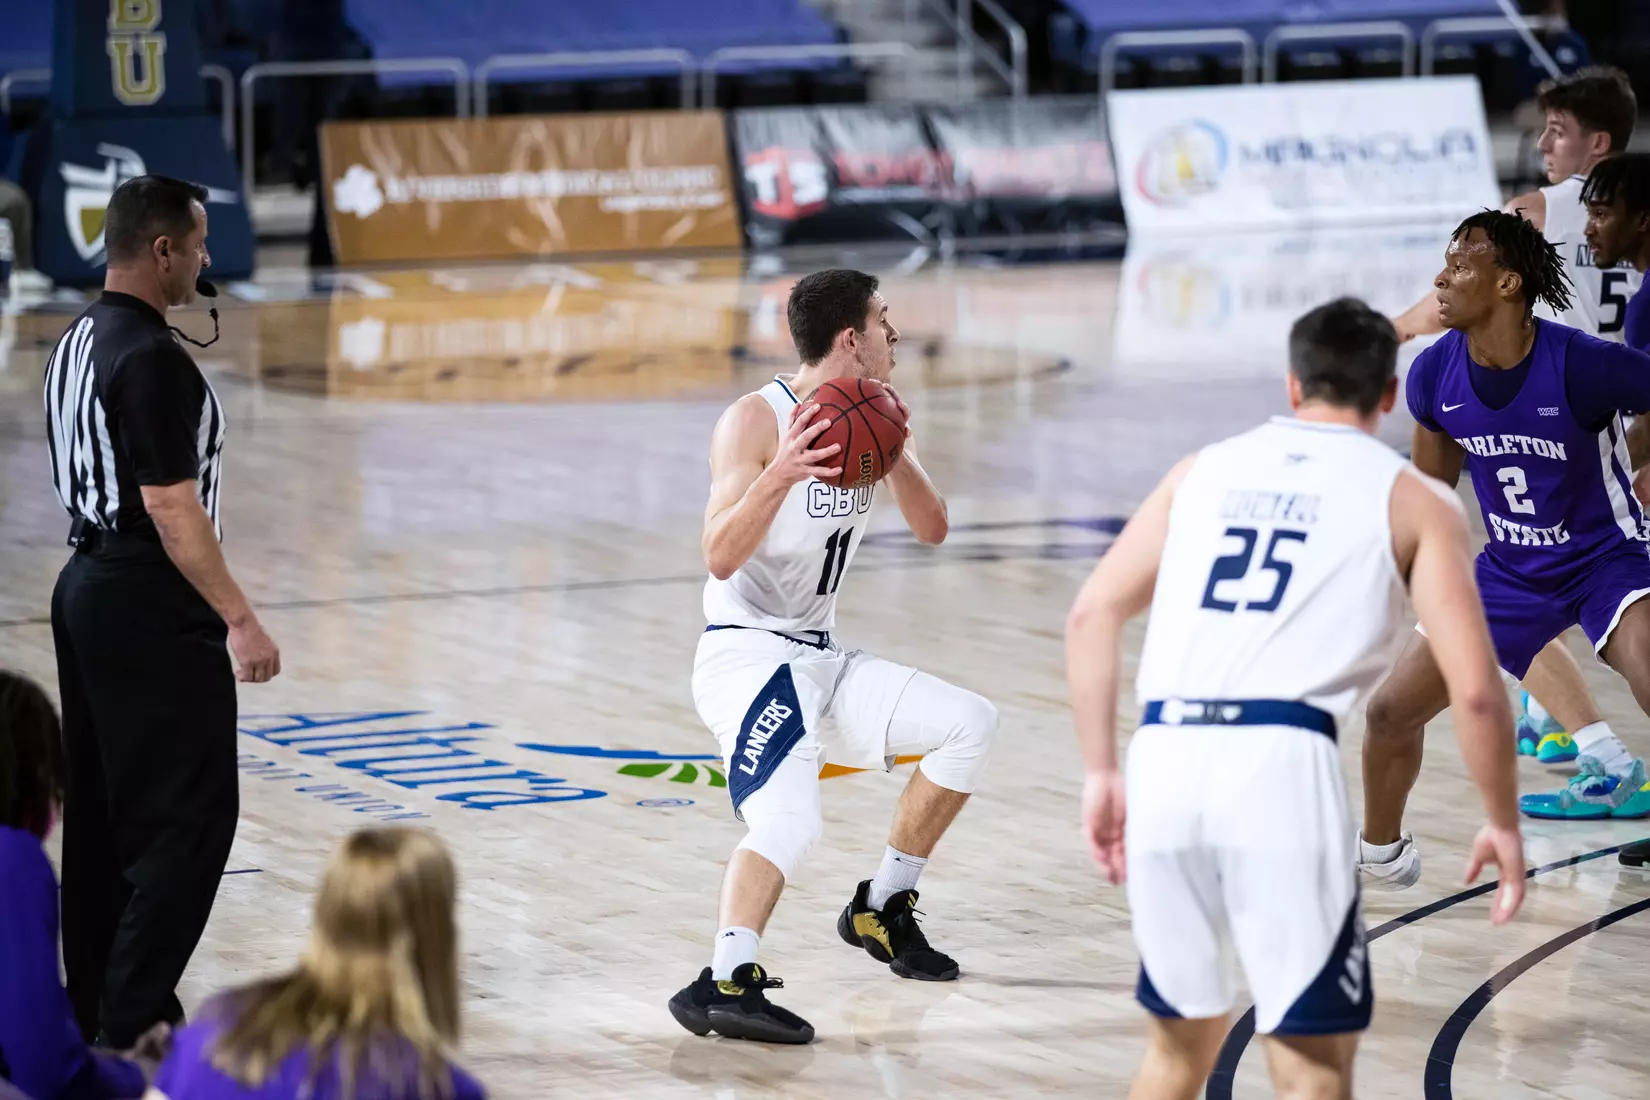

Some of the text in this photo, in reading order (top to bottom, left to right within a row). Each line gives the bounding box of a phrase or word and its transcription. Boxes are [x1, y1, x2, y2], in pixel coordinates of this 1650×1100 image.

[1598, 272, 1629, 333] 5
[1537, 407, 1559, 416] WAC
[807, 481, 875, 518] CBU
[1496, 466, 1535, 515] 2
[816, 526, 854, 596] 11
[1200, 527, 1308, 613] 25
[738, 698, 793, 776] LANCERS
